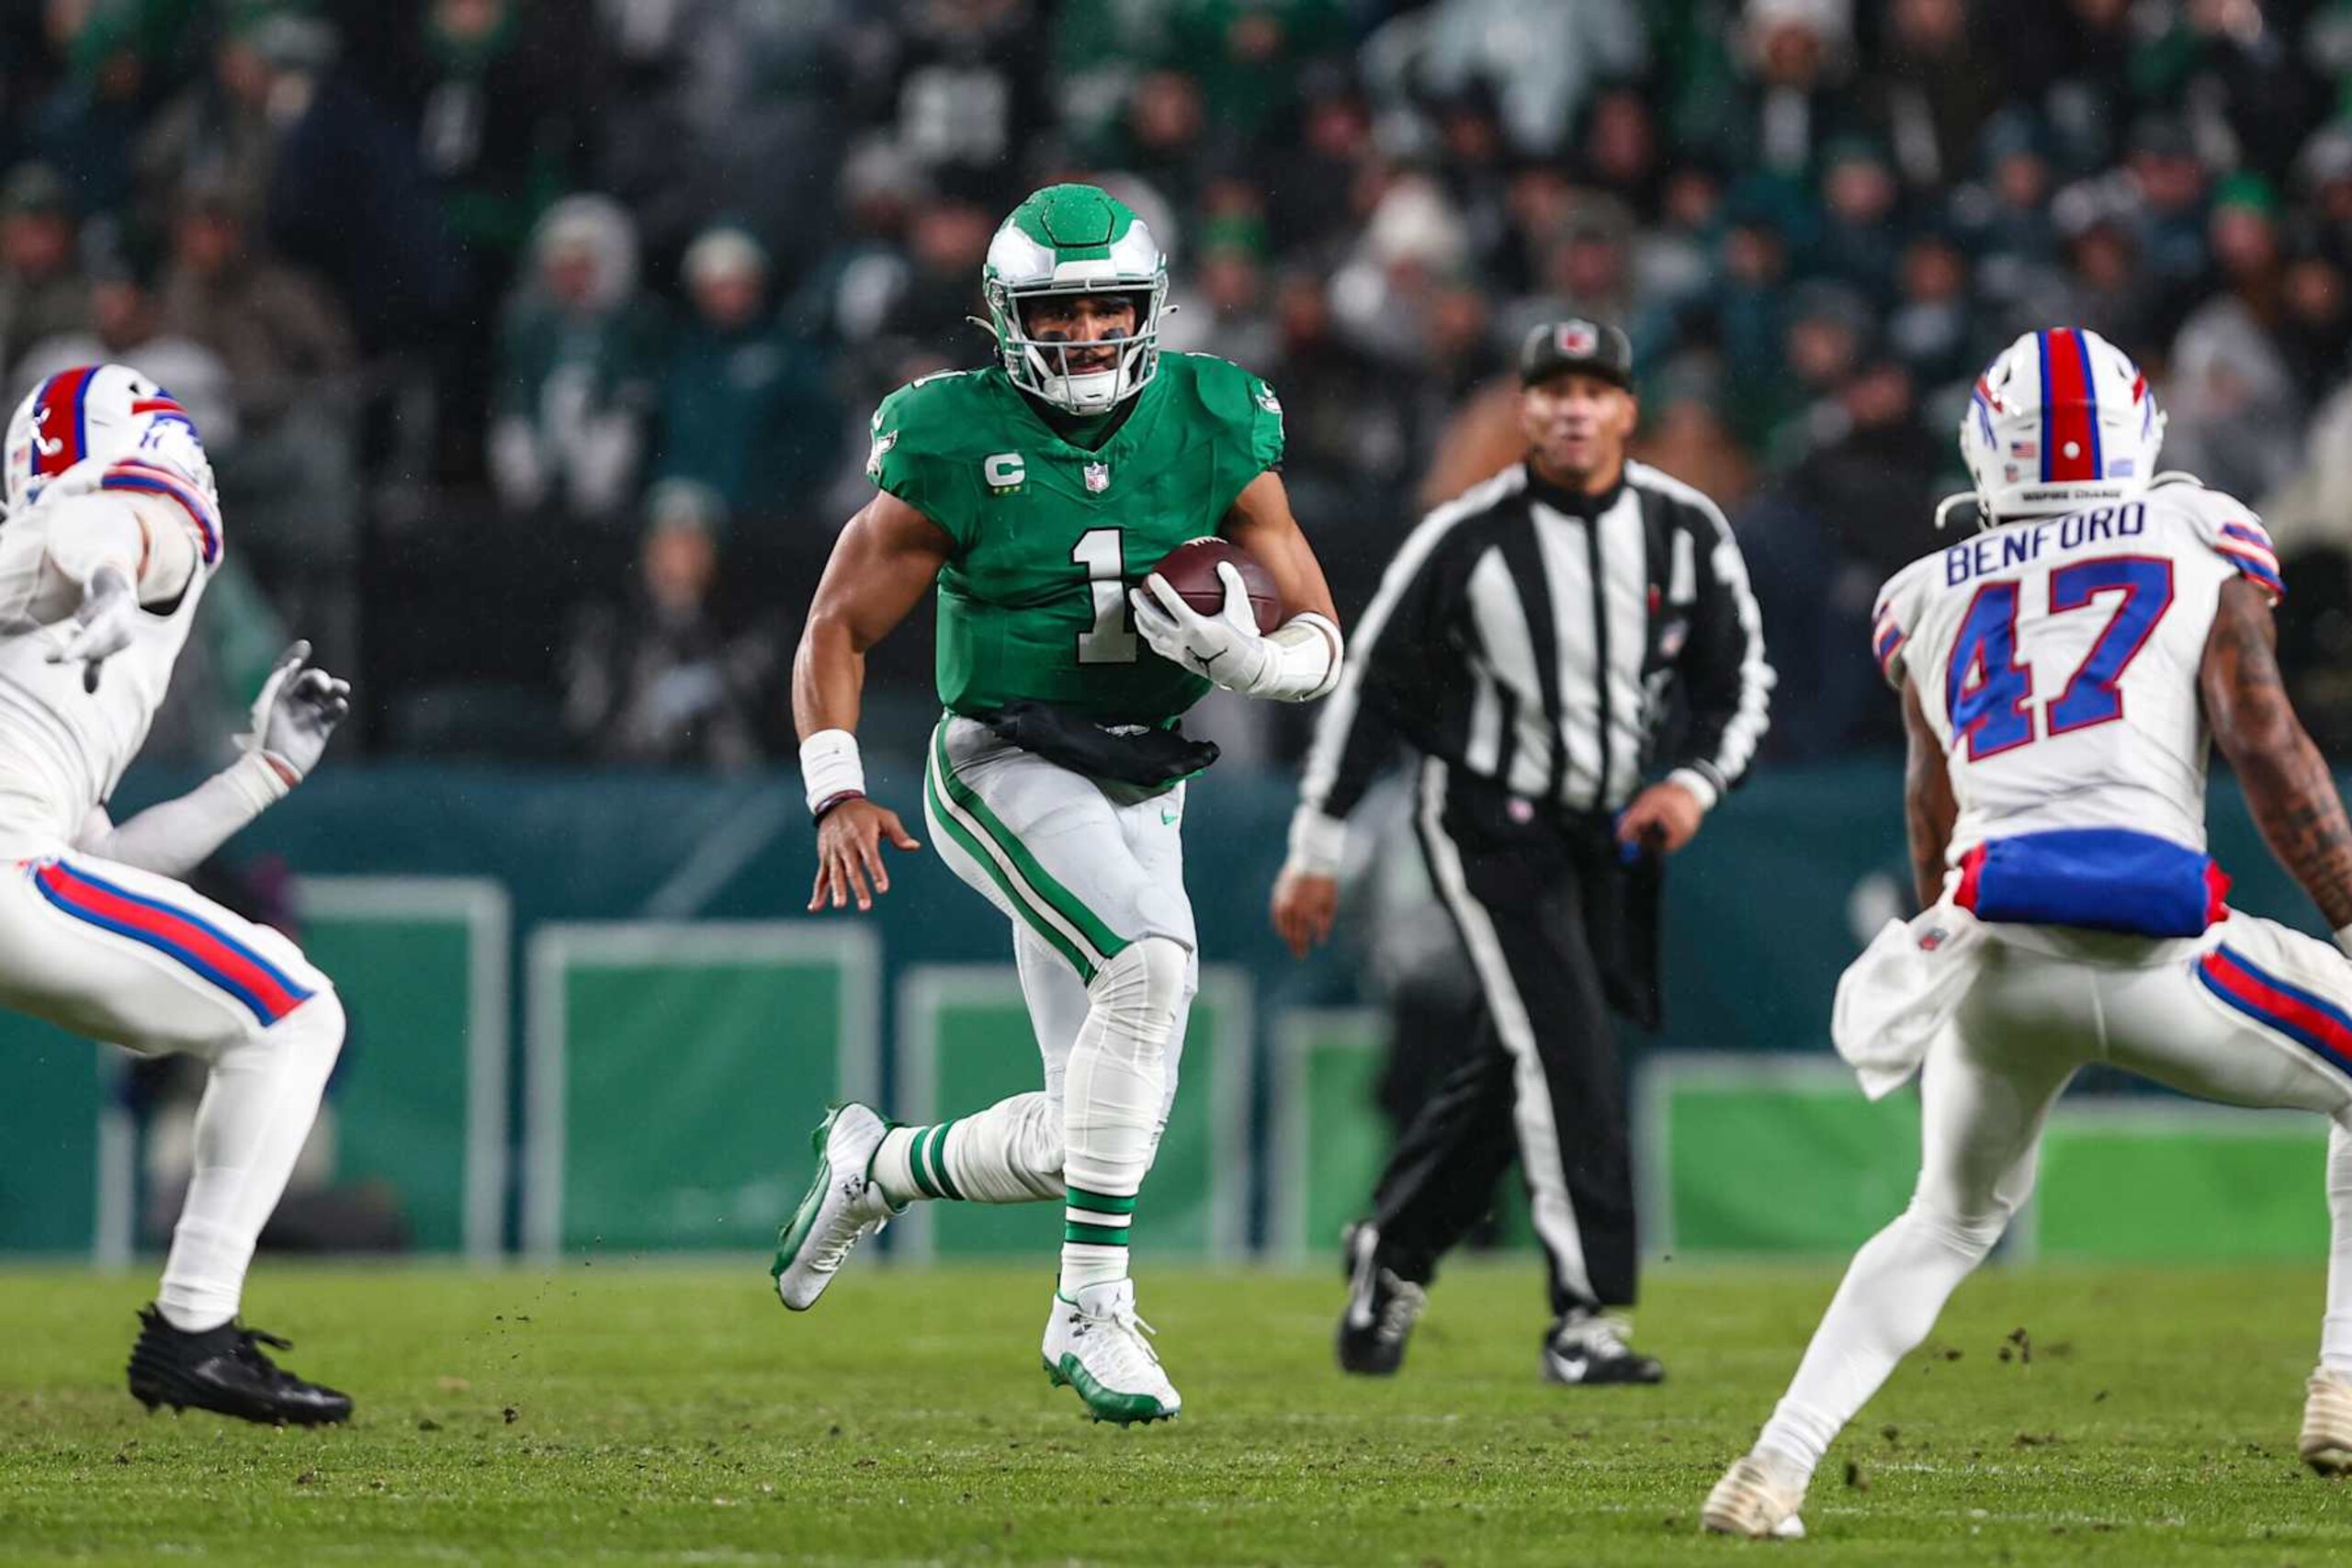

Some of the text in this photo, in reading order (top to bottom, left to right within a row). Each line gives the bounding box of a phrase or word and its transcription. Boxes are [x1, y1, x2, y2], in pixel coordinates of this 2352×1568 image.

[985, 453, 1024, 486] C
[1070, 526, 1137, 664] 1
[1946, 502, 2145, 587] BENFORD
[1945, 554, 2176, 763] 47
